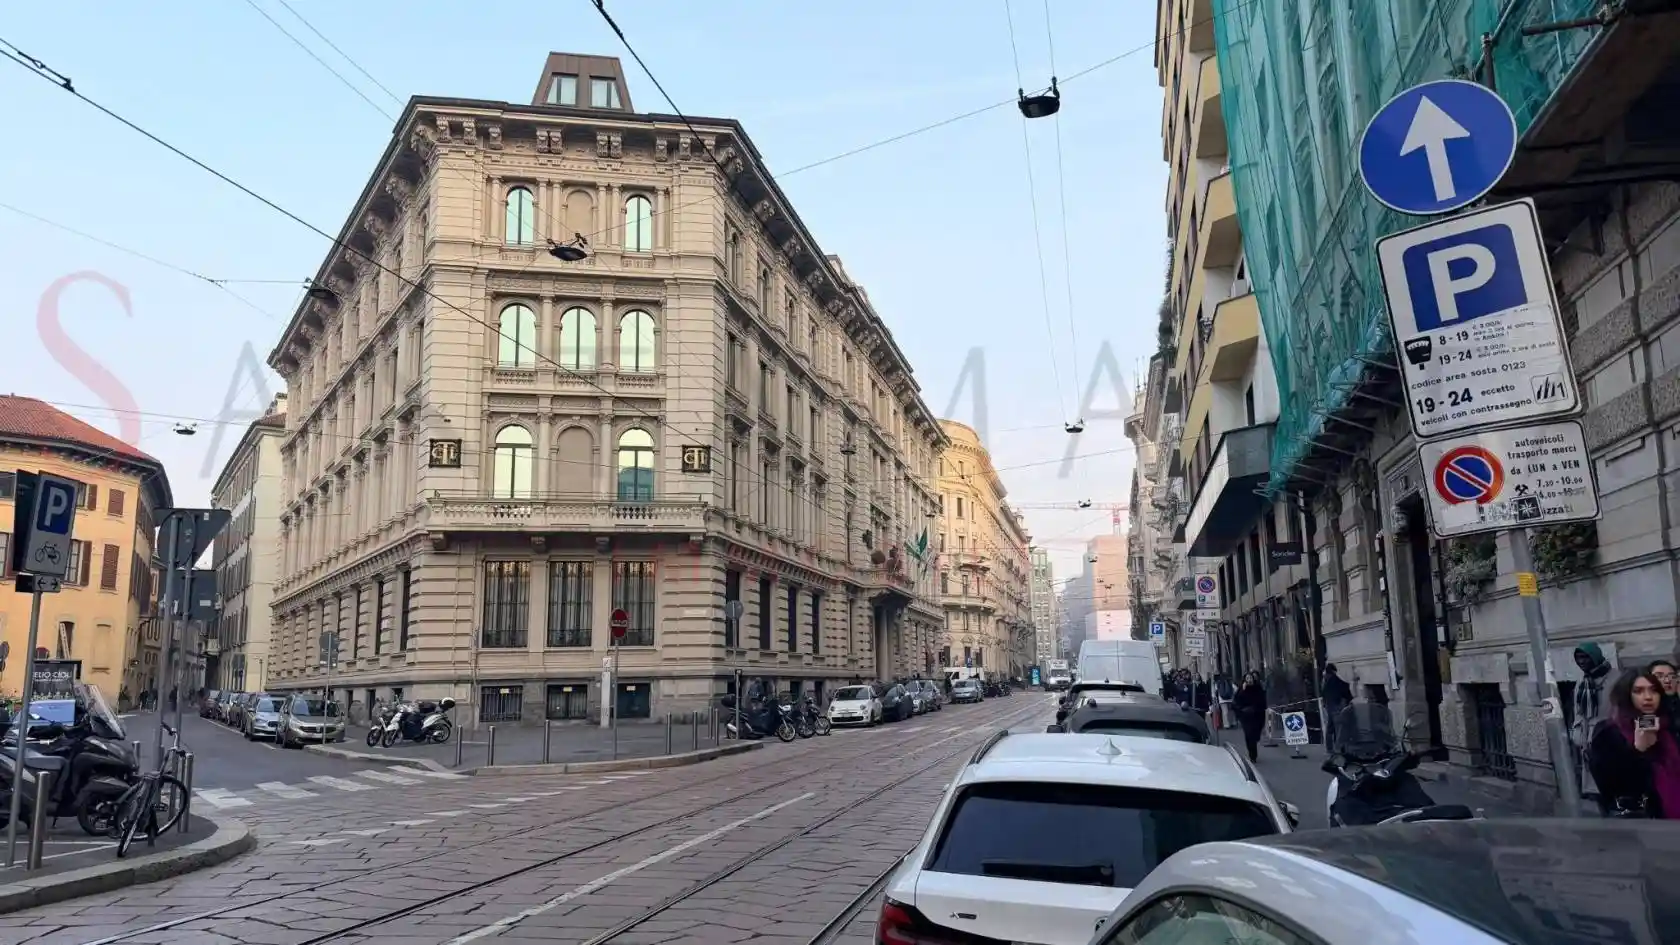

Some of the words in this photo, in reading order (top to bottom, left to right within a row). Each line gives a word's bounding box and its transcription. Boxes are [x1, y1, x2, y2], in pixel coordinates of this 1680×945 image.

[1427, 243, 1496, 322] P
[1411, 377, 1442, 390] codice
[1445, 372, 1467, 382] area
[1470, 366, 1497, 377] sosta
[1480, 384, 1516, 397] eccetto
[1420, 413, 1449, 427] veicoli
[1451, 409, 1468, 420] con
[1470, 398, 1532, 414] contrassegno
[1515, 433, 1565, 448] autoveicoli
[1507, 446, 1549, 461] trasporto
[1551, 444, 1577, 455] merci
[1510, 465, 1521, 476] da
[1527, 462, 1547, 474] LUN
[1552, 463, 1558, 471] a
[1561, 459, 1580, 470] VEN
[44, 486, 67, 526] P
[1271, 549, 1296, 558] Sonder
[1153, 624, 1161, 634] P
